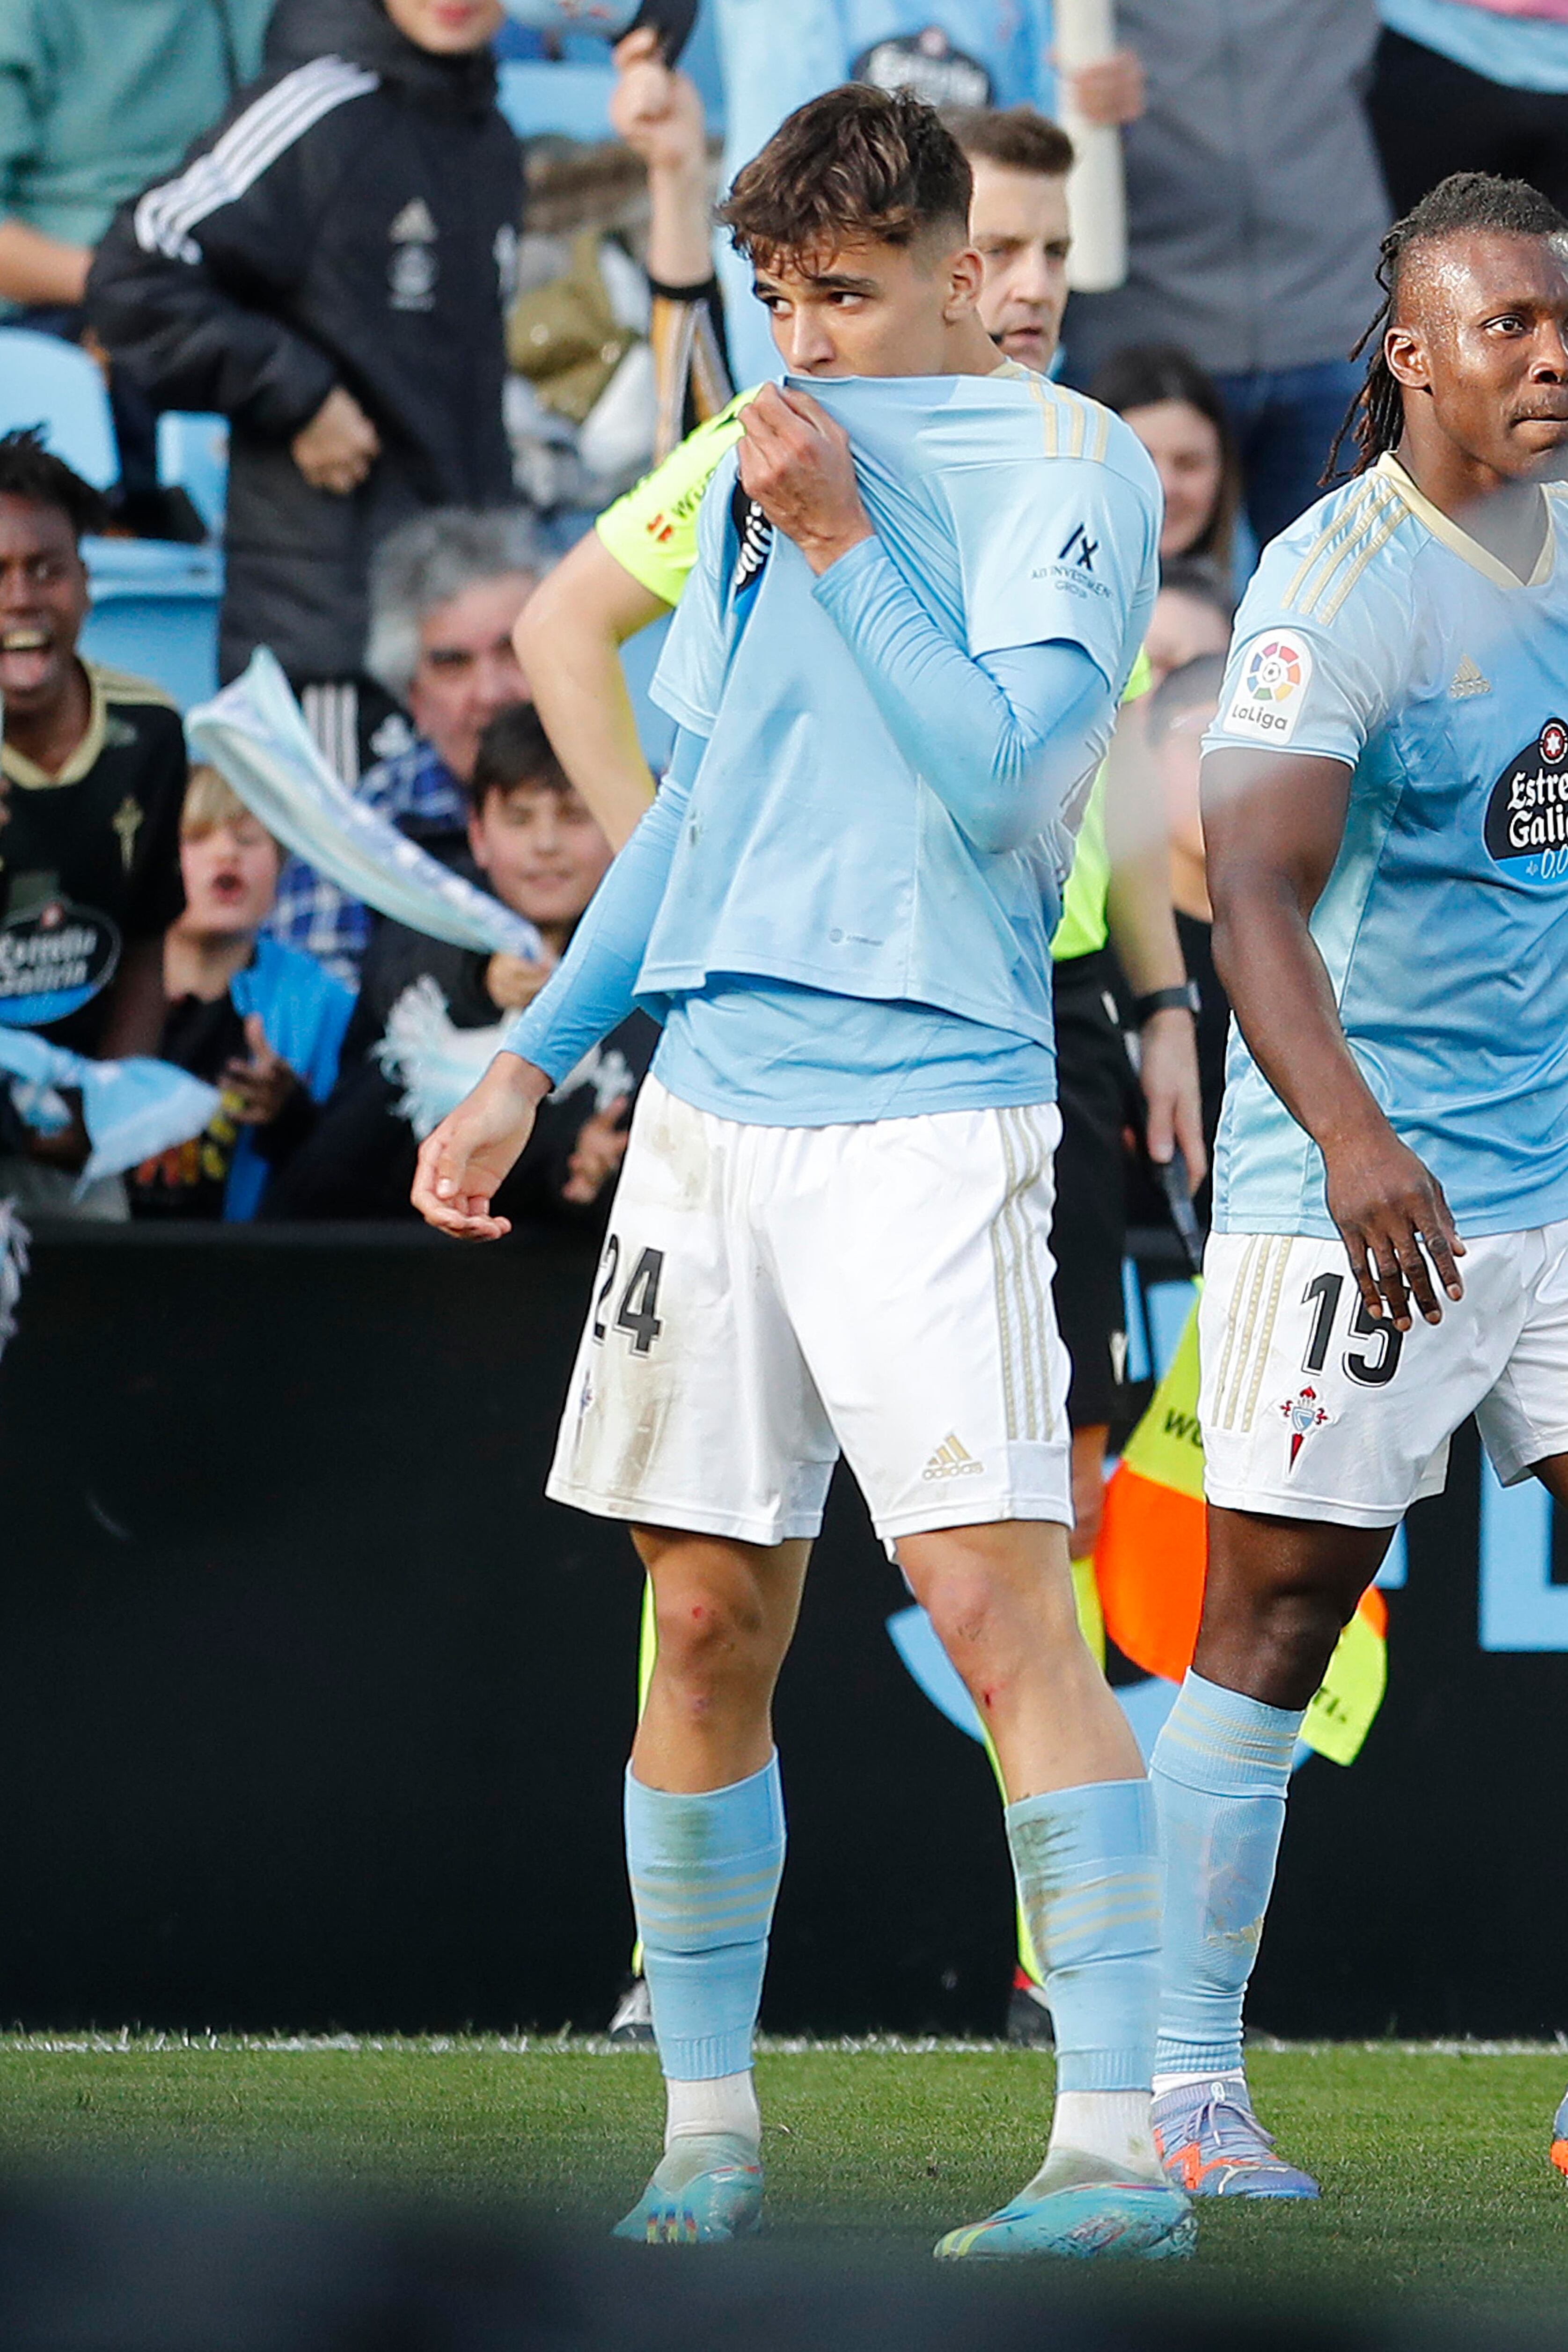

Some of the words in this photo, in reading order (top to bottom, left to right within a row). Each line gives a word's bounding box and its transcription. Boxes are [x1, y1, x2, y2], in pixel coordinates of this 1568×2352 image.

[1232, 703, 1289, 731] LaLiga
[1509, 804, 1568, 848] Gali
[593, 1233, 664, 1356] 24
[1301, 1273, 1405, 1386] 15
[923, 1461, 984, 1481] adidas
